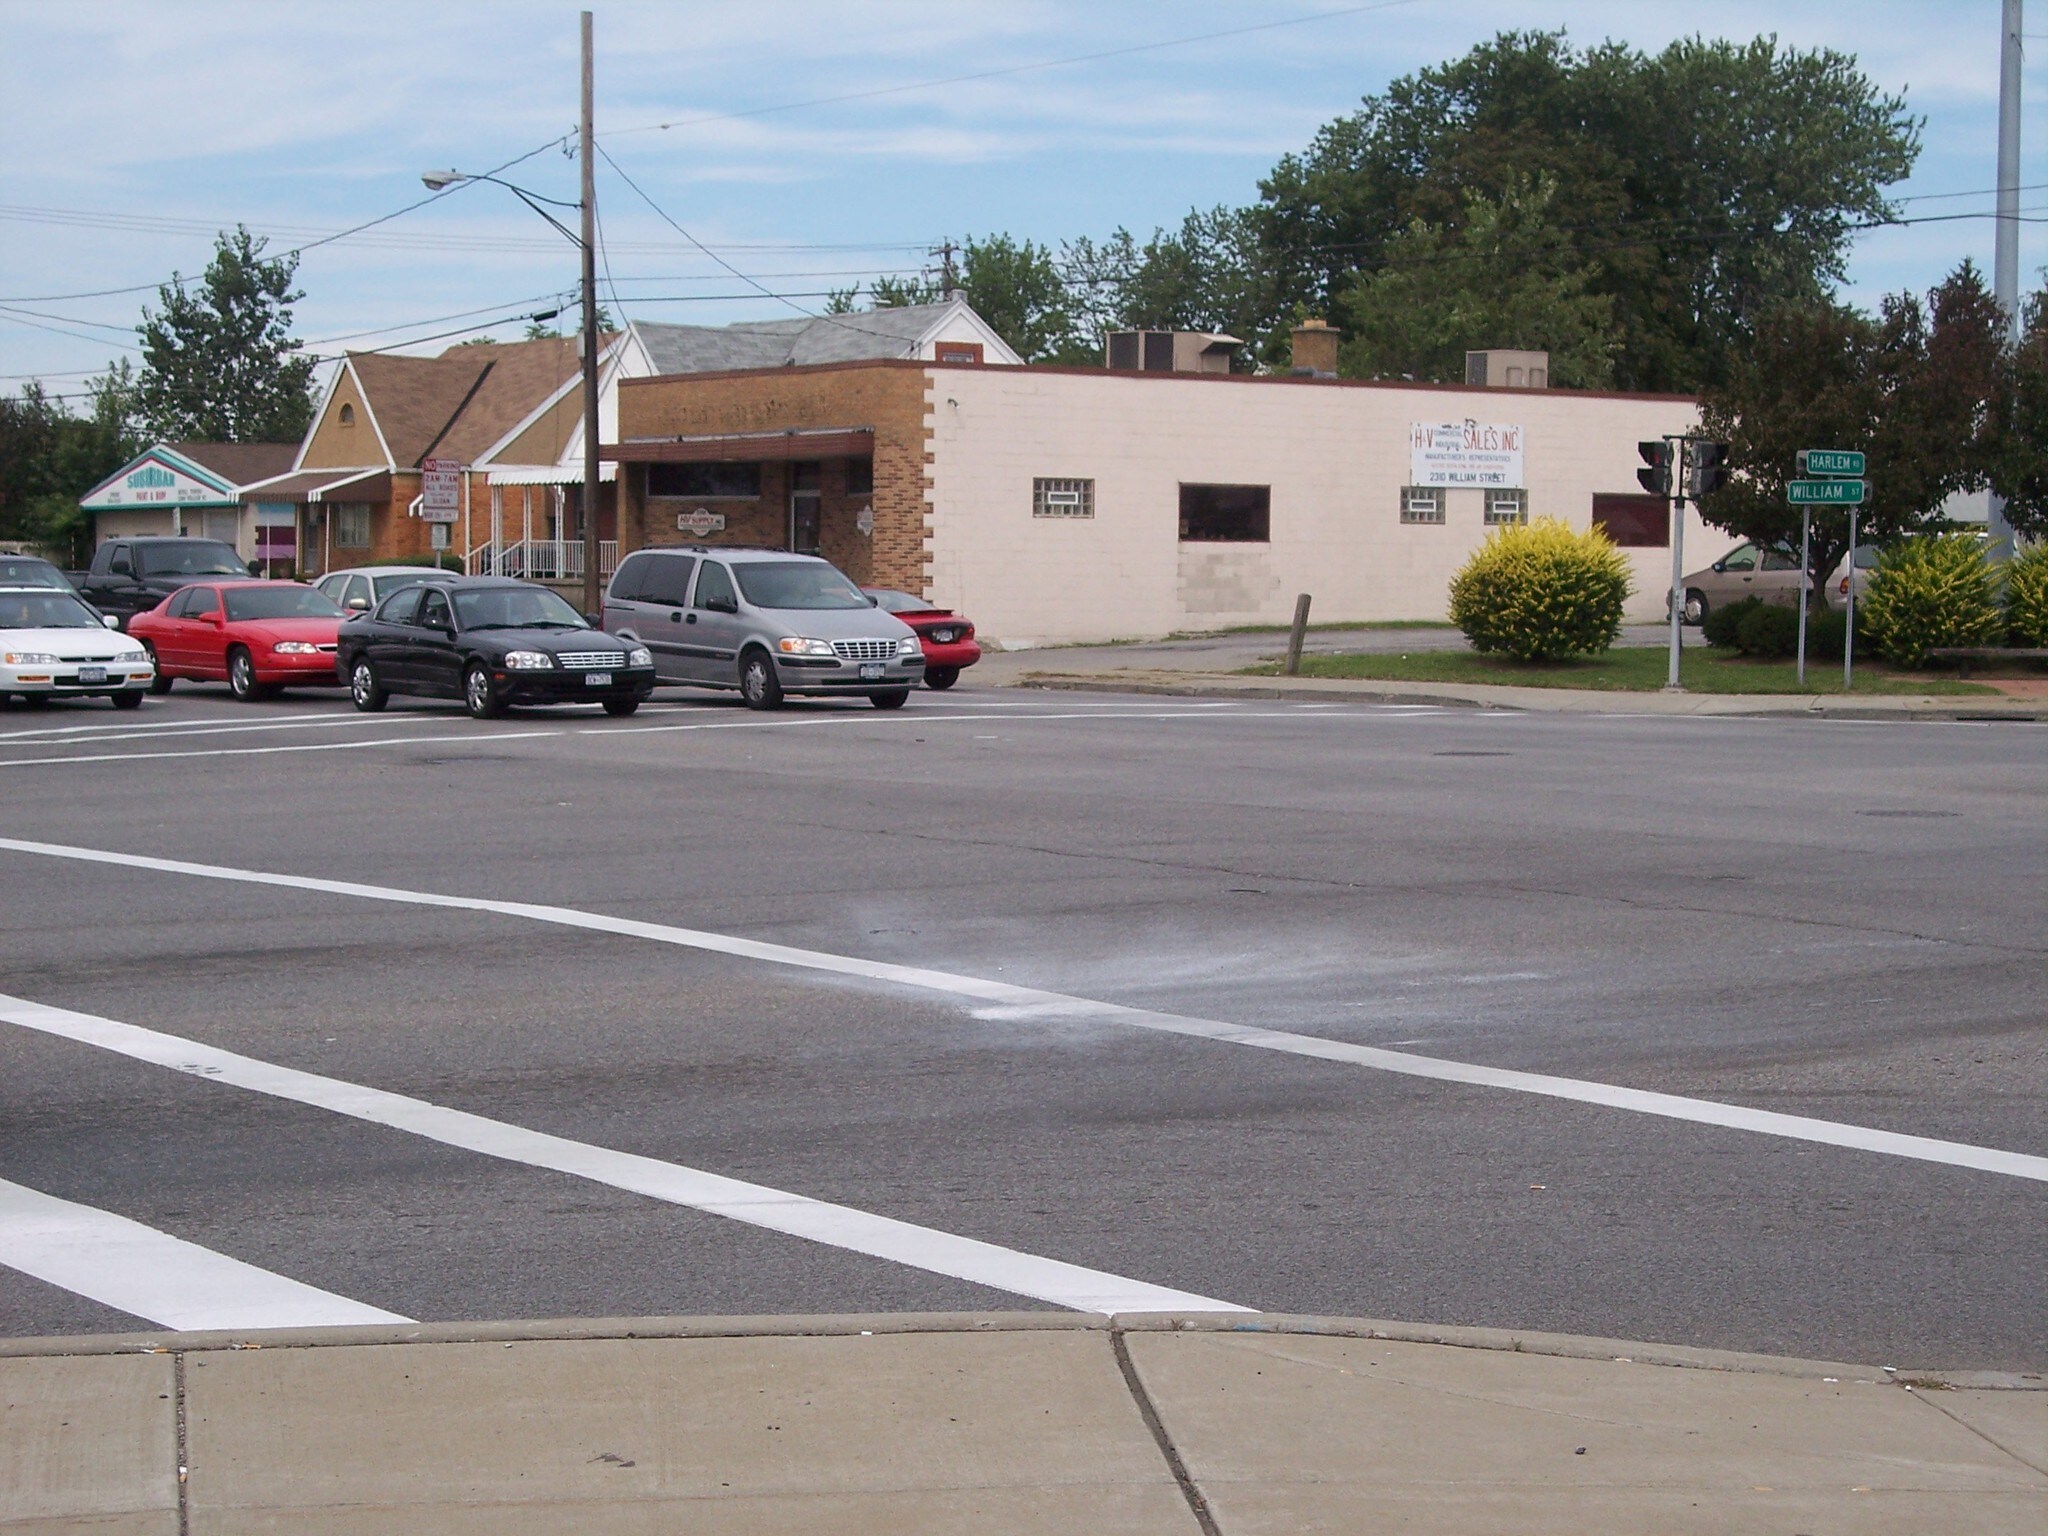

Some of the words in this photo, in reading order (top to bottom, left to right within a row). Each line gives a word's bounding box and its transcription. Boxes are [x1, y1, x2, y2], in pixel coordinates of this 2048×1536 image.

[1463, 428, 1498, 451] SALES
[1811, 455, 1850, 469] HARLEM
[127, 466, 175, 489] SUBURBAN
[1429, 472, 1446, 482] 2310
[1448, 472, 1477, 482] WILLIAM
[1479, 473, 1506, 483] STREET
[1792, 485, 1843, 499] WILLIAM
